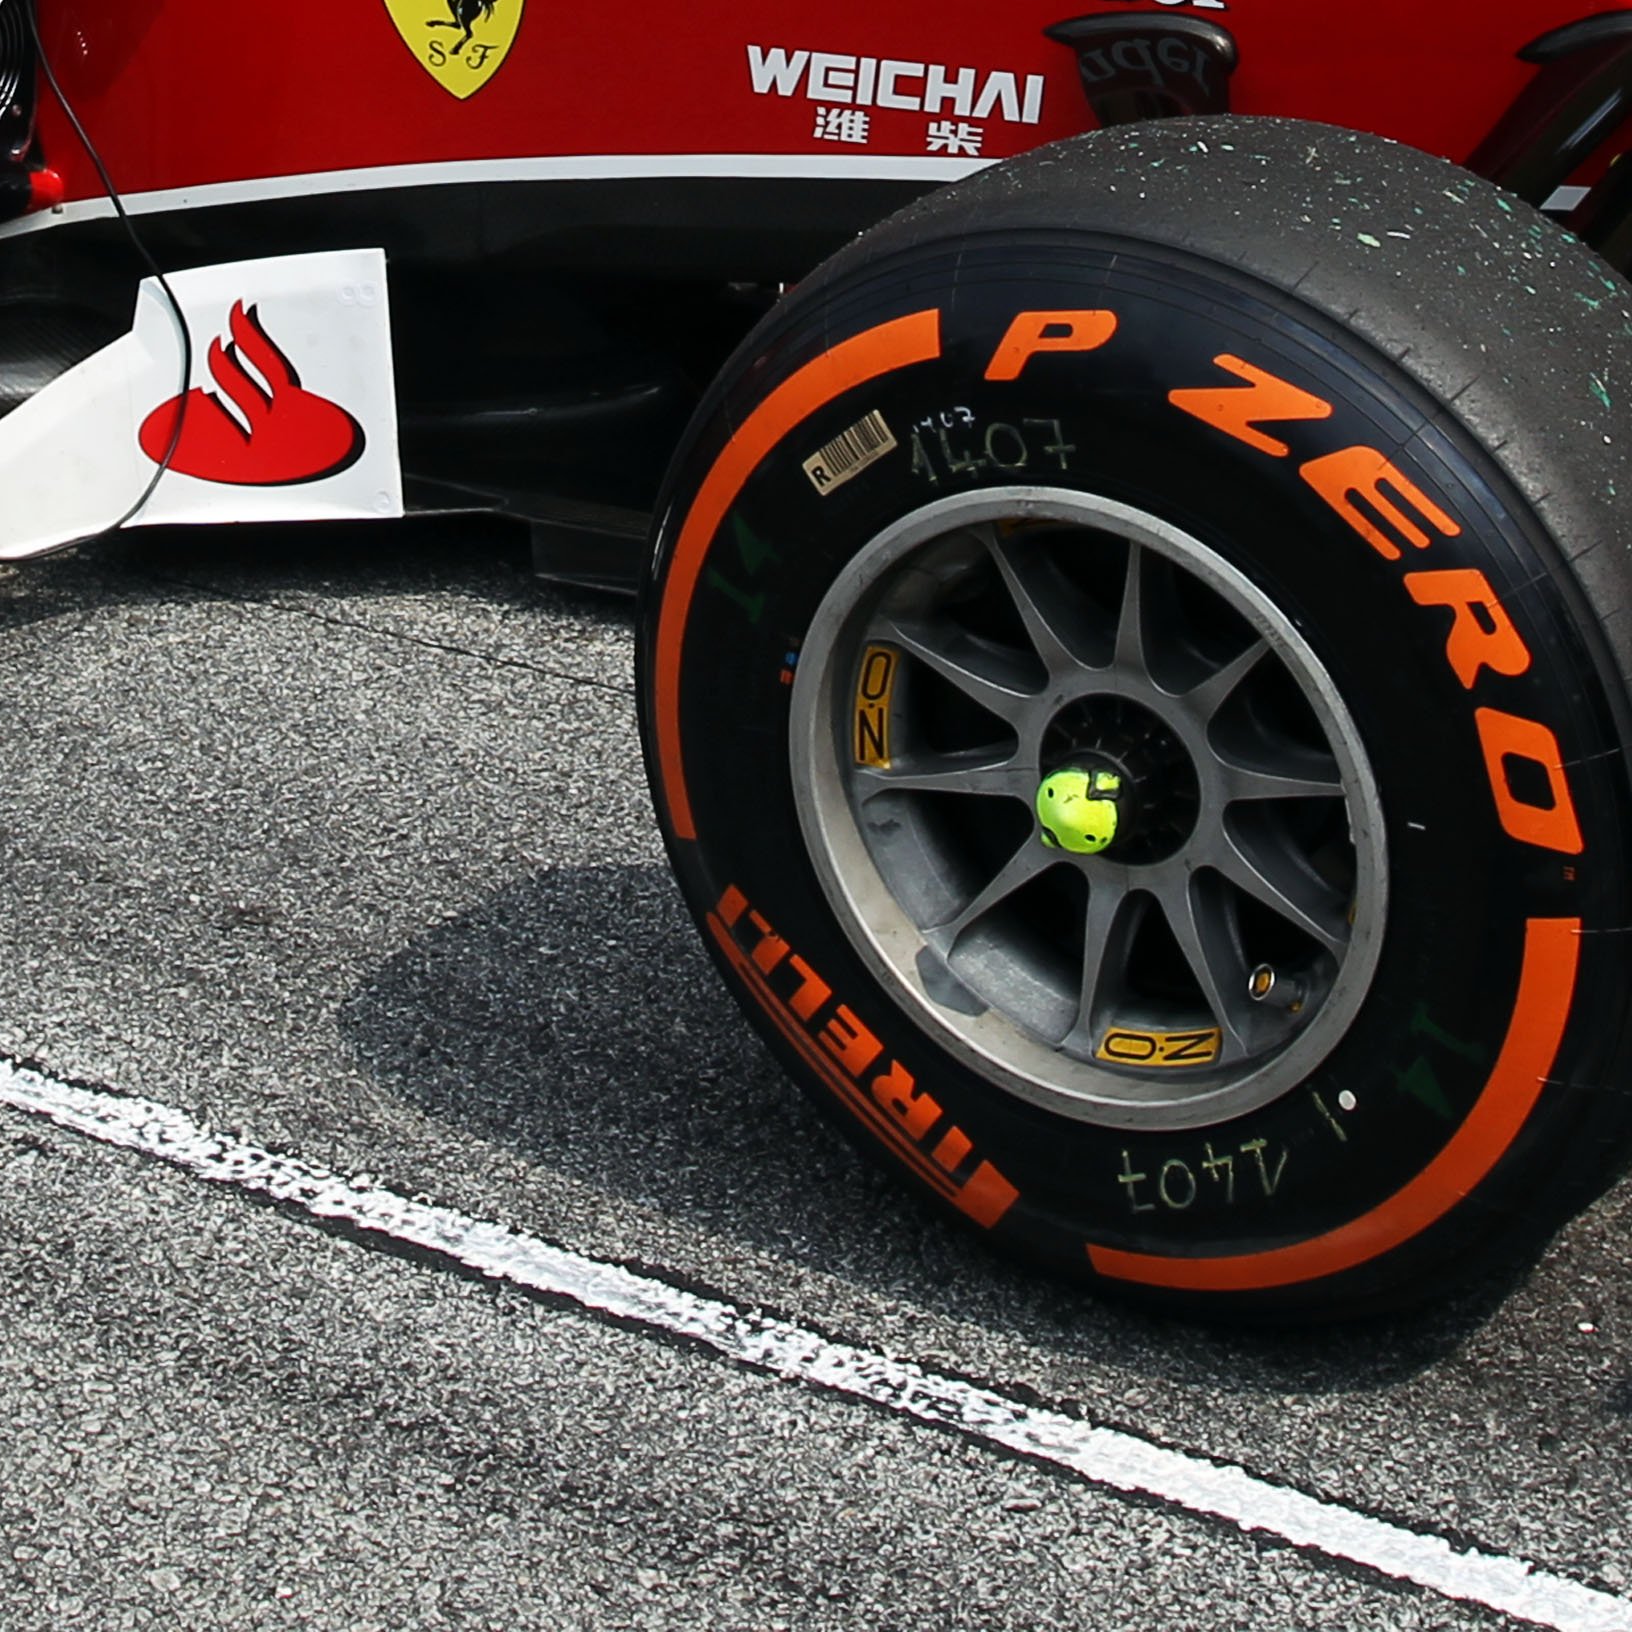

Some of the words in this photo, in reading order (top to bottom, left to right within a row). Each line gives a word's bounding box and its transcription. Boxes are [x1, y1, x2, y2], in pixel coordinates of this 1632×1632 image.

[746, 44, 1046, 125] WEICHAI
[812, 106, 985, 156] 潍柴
[810, 464, 832, 487] R
[984, 309, 1118, 382] P
[1168, 353, 1585, 855] ZERO
[705, 883, 1021, 1229] PIRELLI
